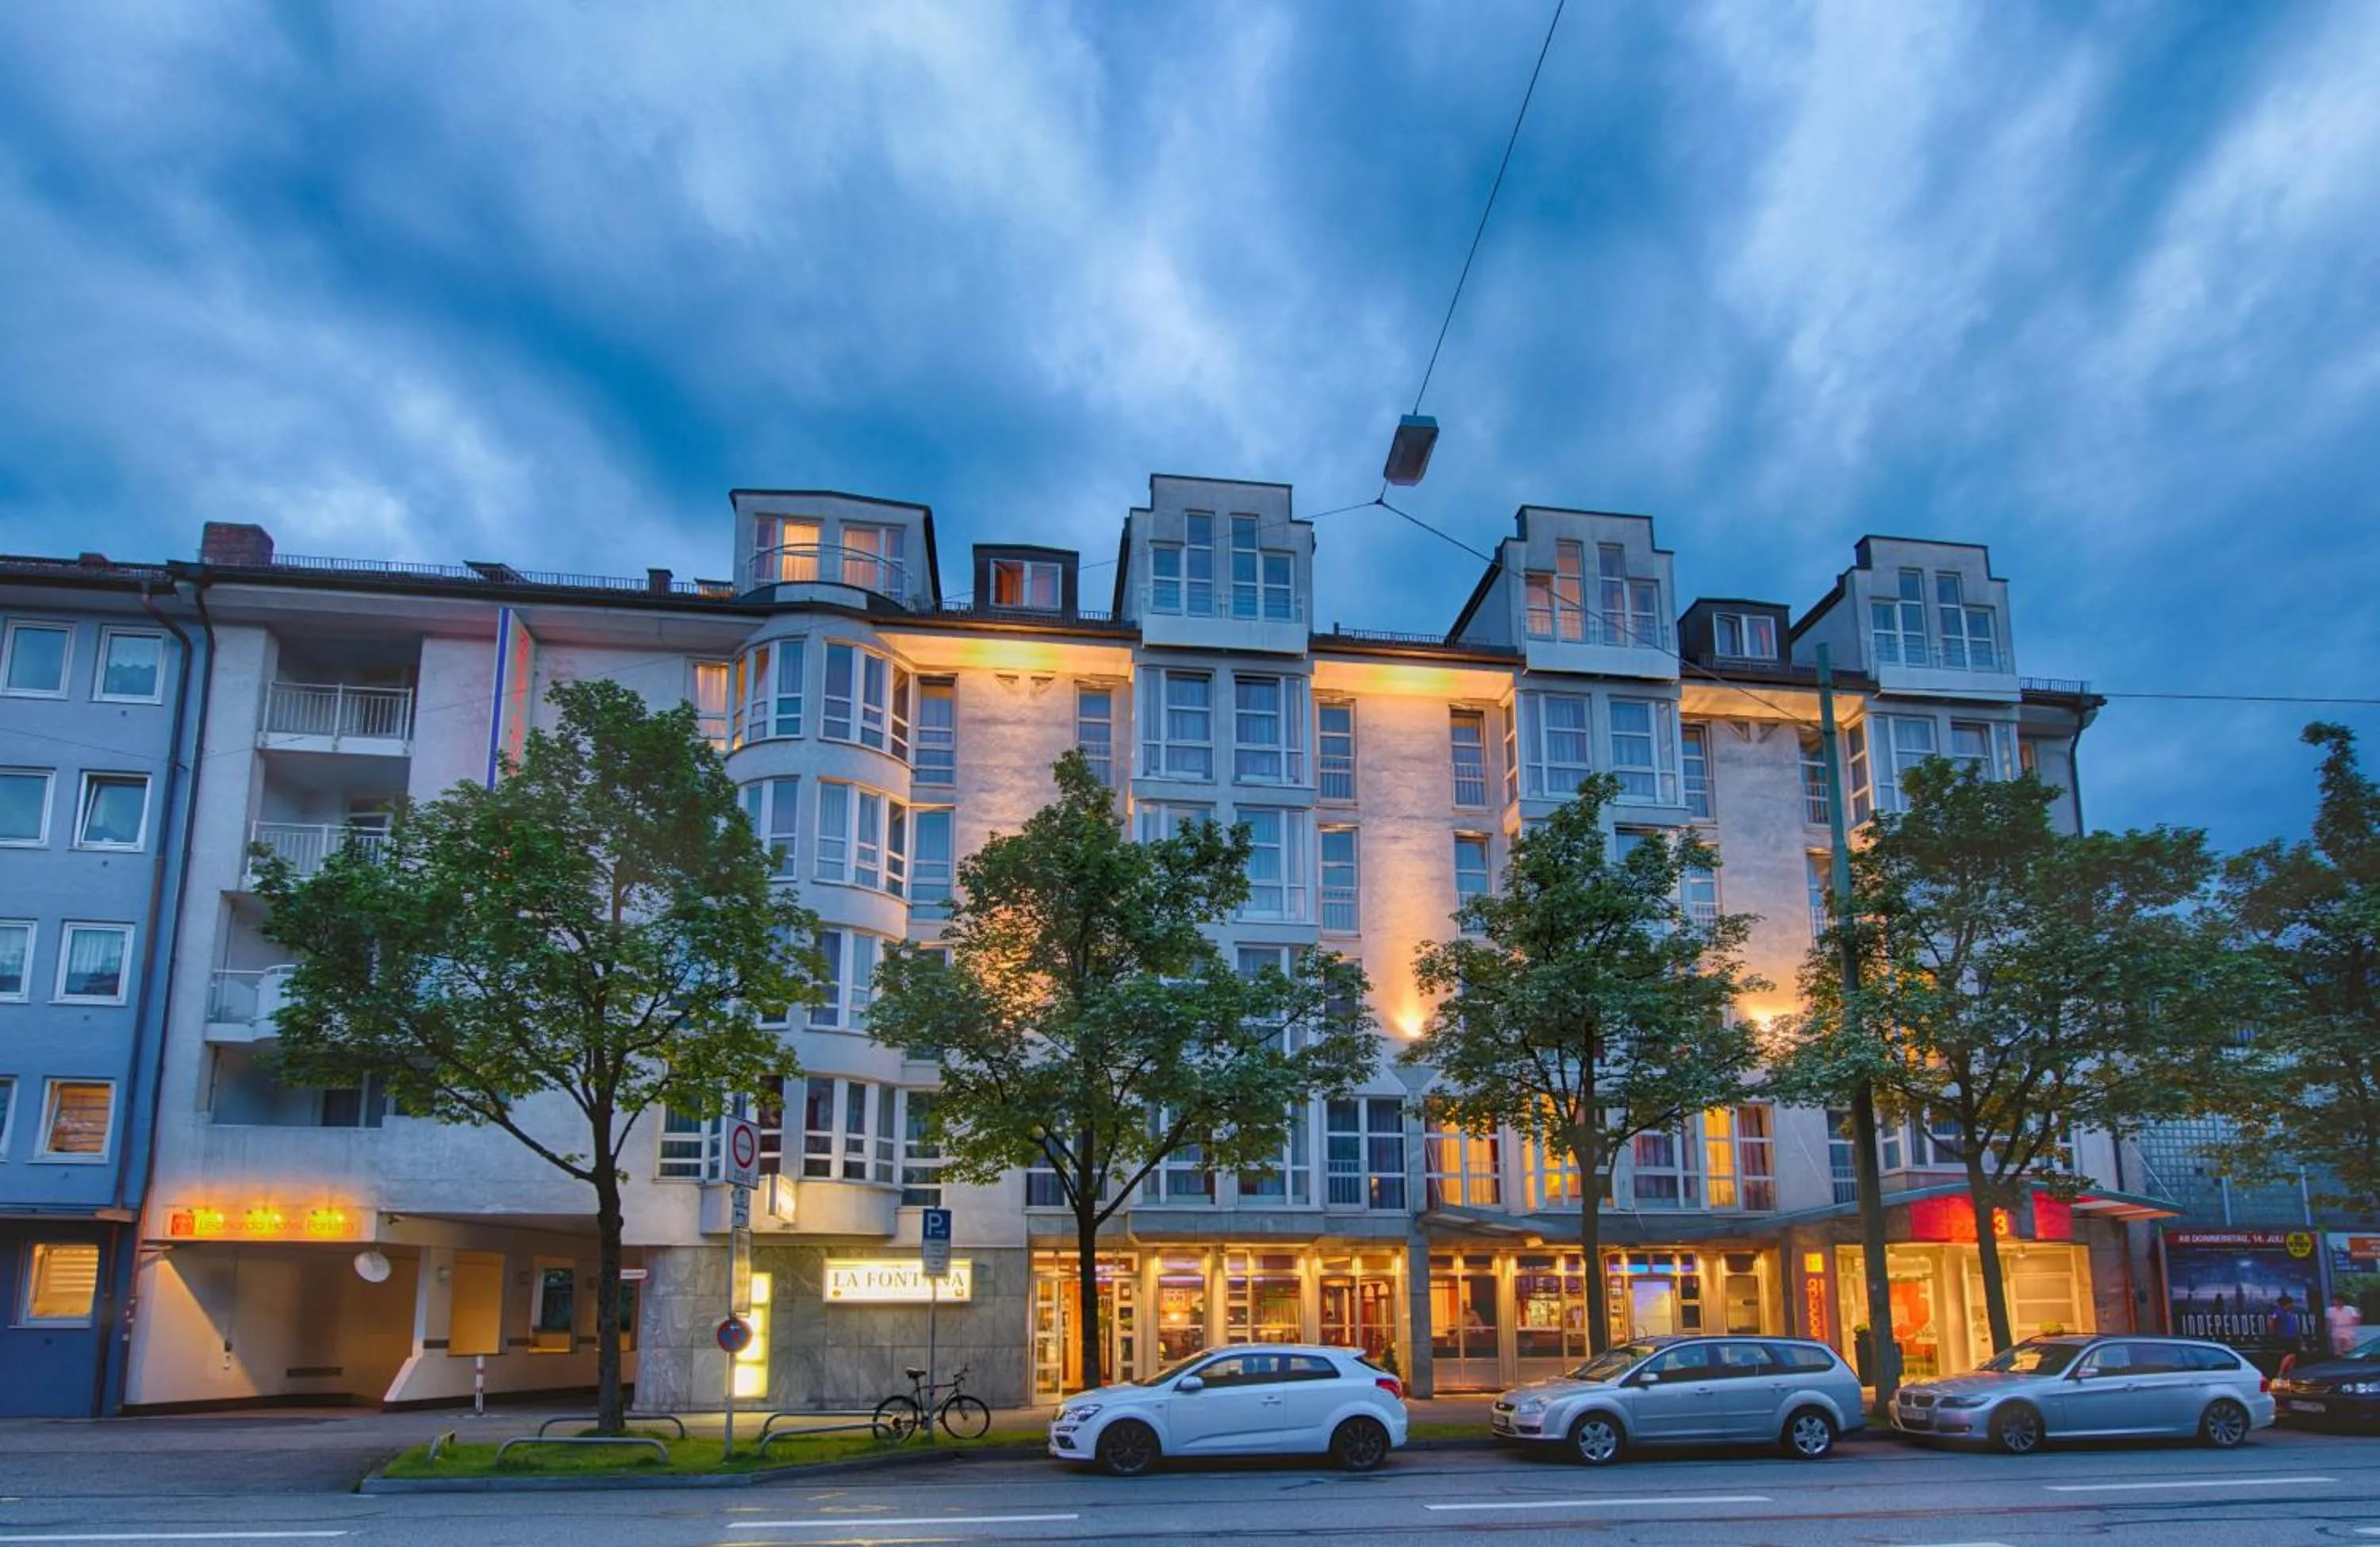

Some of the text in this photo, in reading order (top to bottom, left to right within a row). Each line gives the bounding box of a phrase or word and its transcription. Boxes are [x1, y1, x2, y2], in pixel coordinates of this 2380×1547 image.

[927, 1212, 942, 1236] P
[834, 1272, 858, 1288] LA
[2182, 1314, 2267, 1335] INDEPENDEN
